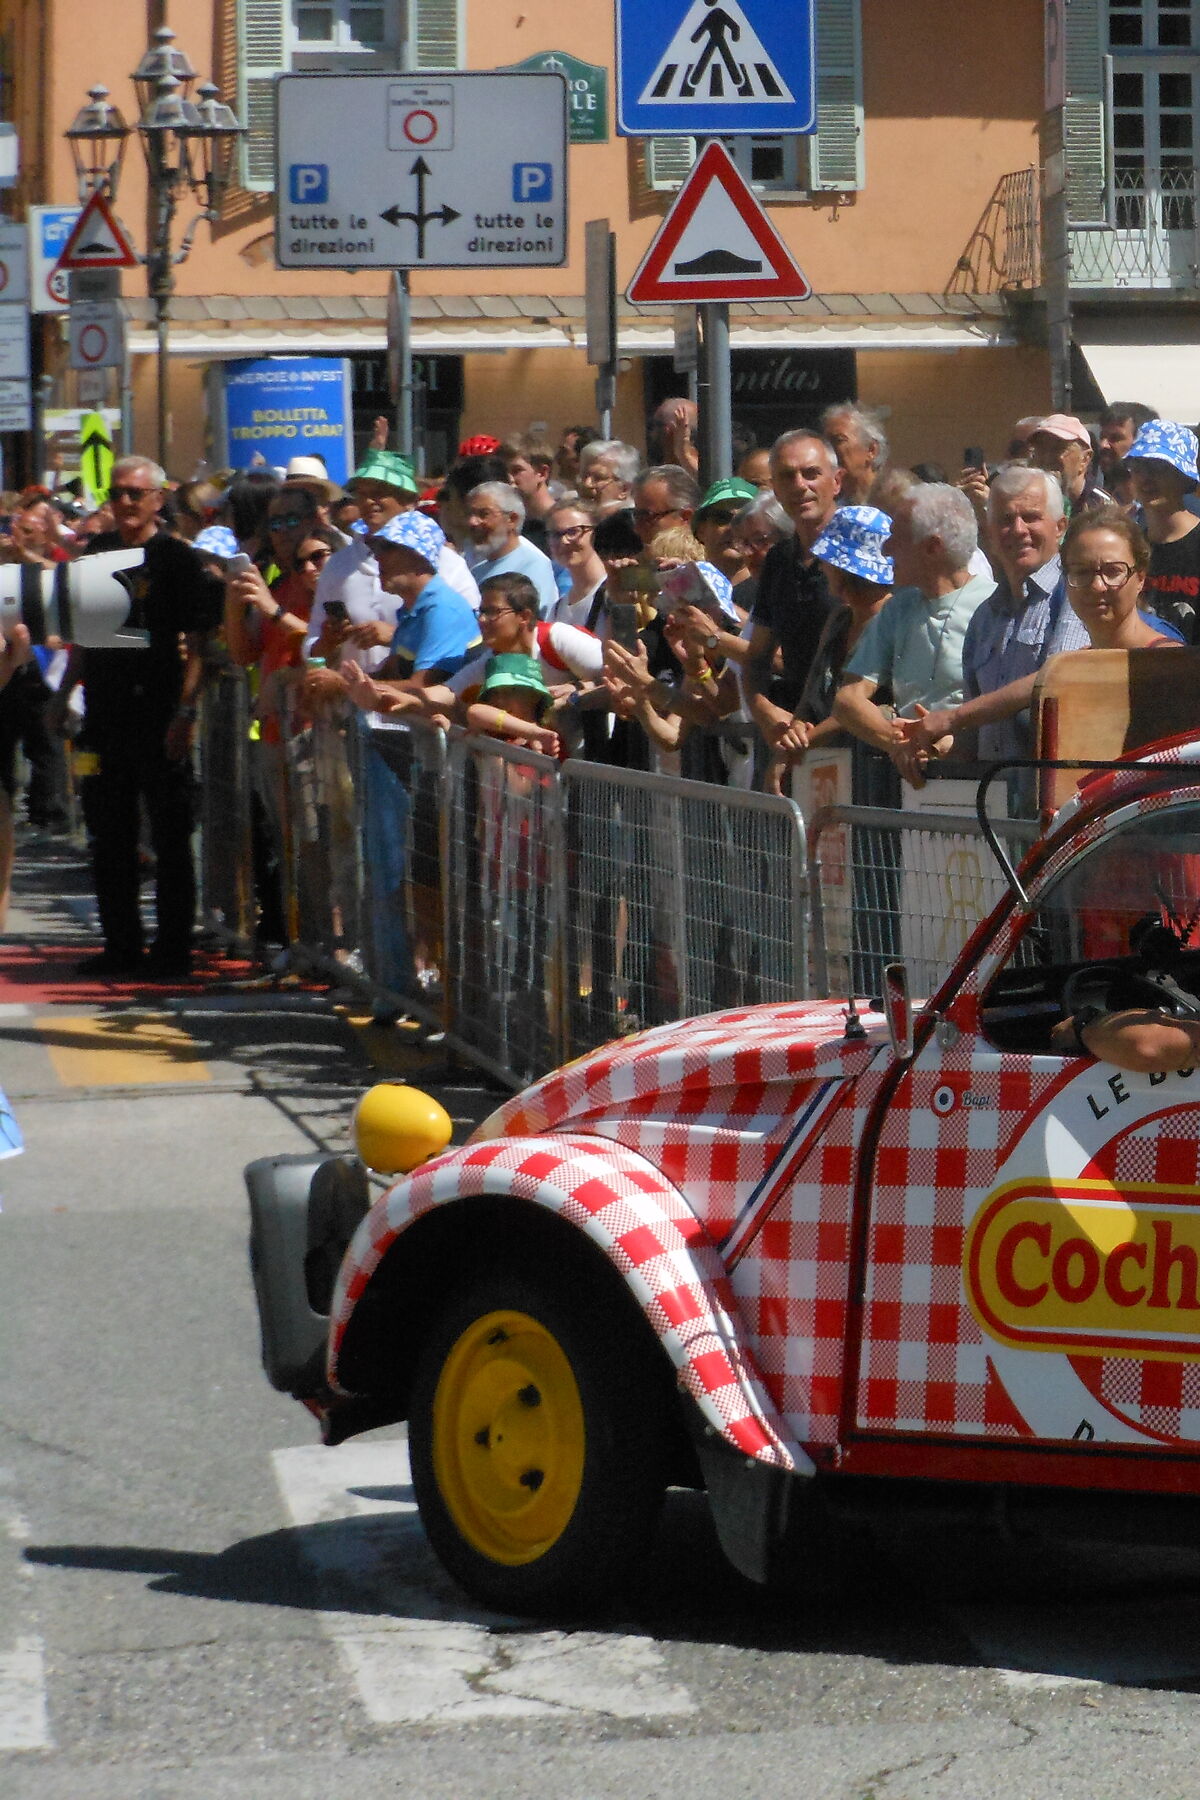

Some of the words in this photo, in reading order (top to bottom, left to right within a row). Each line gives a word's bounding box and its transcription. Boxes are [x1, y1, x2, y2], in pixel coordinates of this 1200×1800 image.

[297, 169, 321, 200] P
[522, 168, 546, 198] P
[290, 214, 339, 229] tutte
[350, 215, 368, 230] le
[475, 213, 525, 228] tutte
[536, 213, 555, 228] le
[290, 238, 375, 253] direzioni
[467, 237, 554, 253] direzioni
[253, 408, 327, 422] BOLLETTA
[232, 425, 298, 439] TROPPO
[1086, 1073, 1131, 1120] LE
